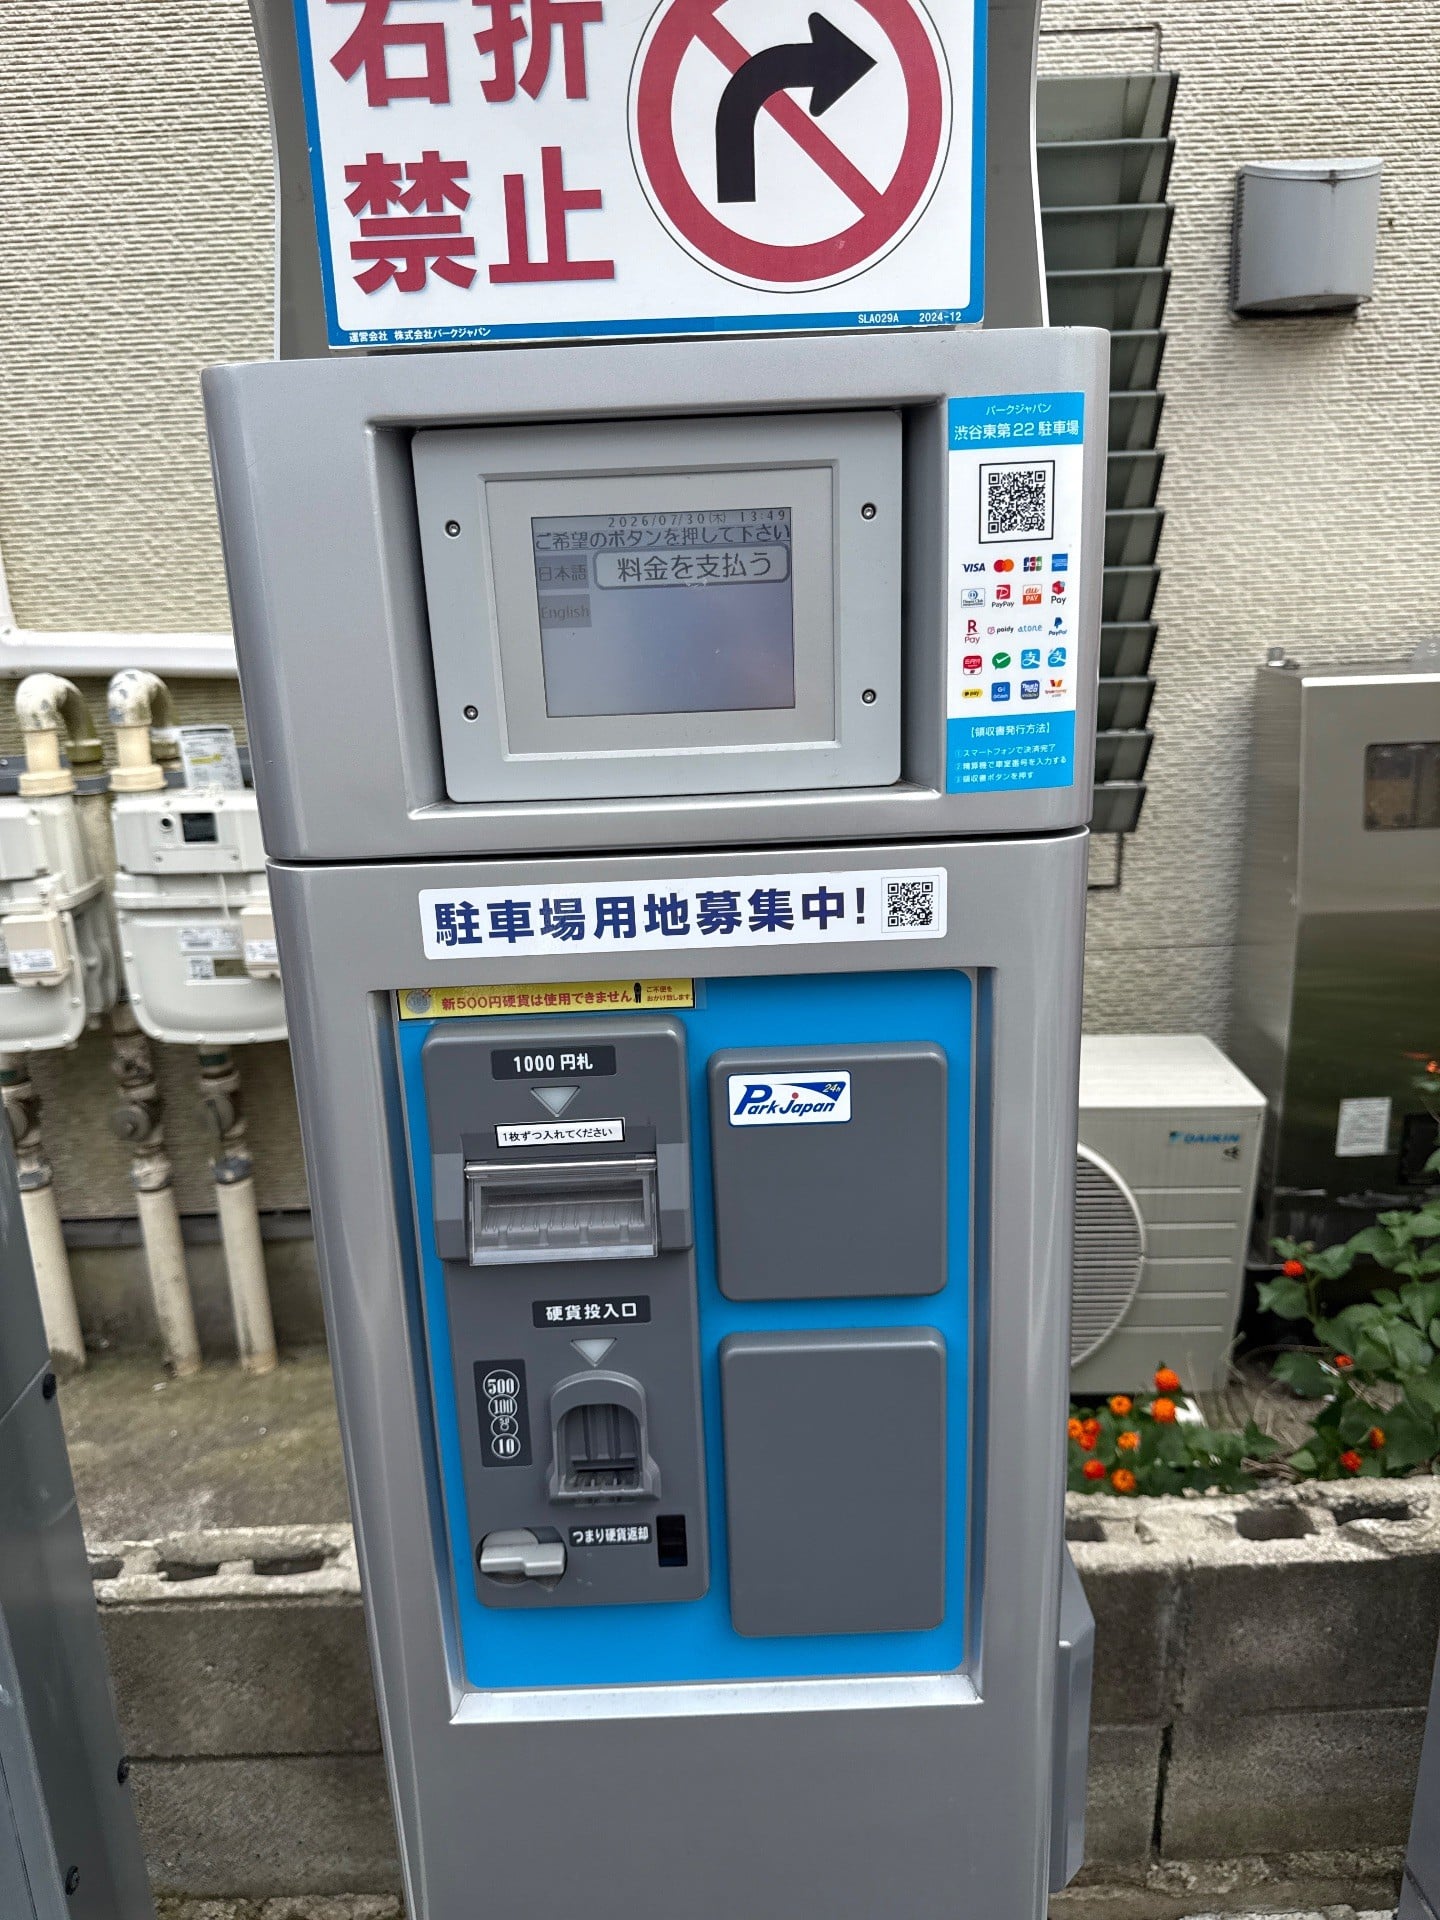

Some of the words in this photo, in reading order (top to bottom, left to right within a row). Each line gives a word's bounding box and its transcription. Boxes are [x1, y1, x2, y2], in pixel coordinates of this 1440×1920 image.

[329, 0, 604, 107] 右折
[343, 146, 615, 295] 禁止
[858, 313, 900, 323] SLA029A
[919, 311, 962, 323] 2024-12
[349, 331, 388, 343] 運営会社
[740, 510, 786, 522] 13:49
[535, 523, 790, 551] ご希望のボタンを押して下さい
[538, 564, 588, 582] 日本語
[617, 552, 772, 583] 料金を支払う
[961, 562, 986, 573] VISA
[1051, 595, 1067, 605] Pay
[541, 604, 590, 621] English
[1018, 624, 1043, 633] atone
[1048, 629, 1067, 637] PayPal
[965, 636, 980, 644] Pay
[822, 1083, 842, 1093] 24h
[733, 1084, 780, 1115] Park
[502, 1127, 613, 1142] 1枚ずつ入れてください
[545, 1301, 638, 1322] 硬貨投入口
[487, 1378, 515, 1395] 500
[493, 1399, 513, 1415] 100
[499, 1438, 515, 1454] 10
[572, 1525, 649, 1544] つまり硬貨返却
